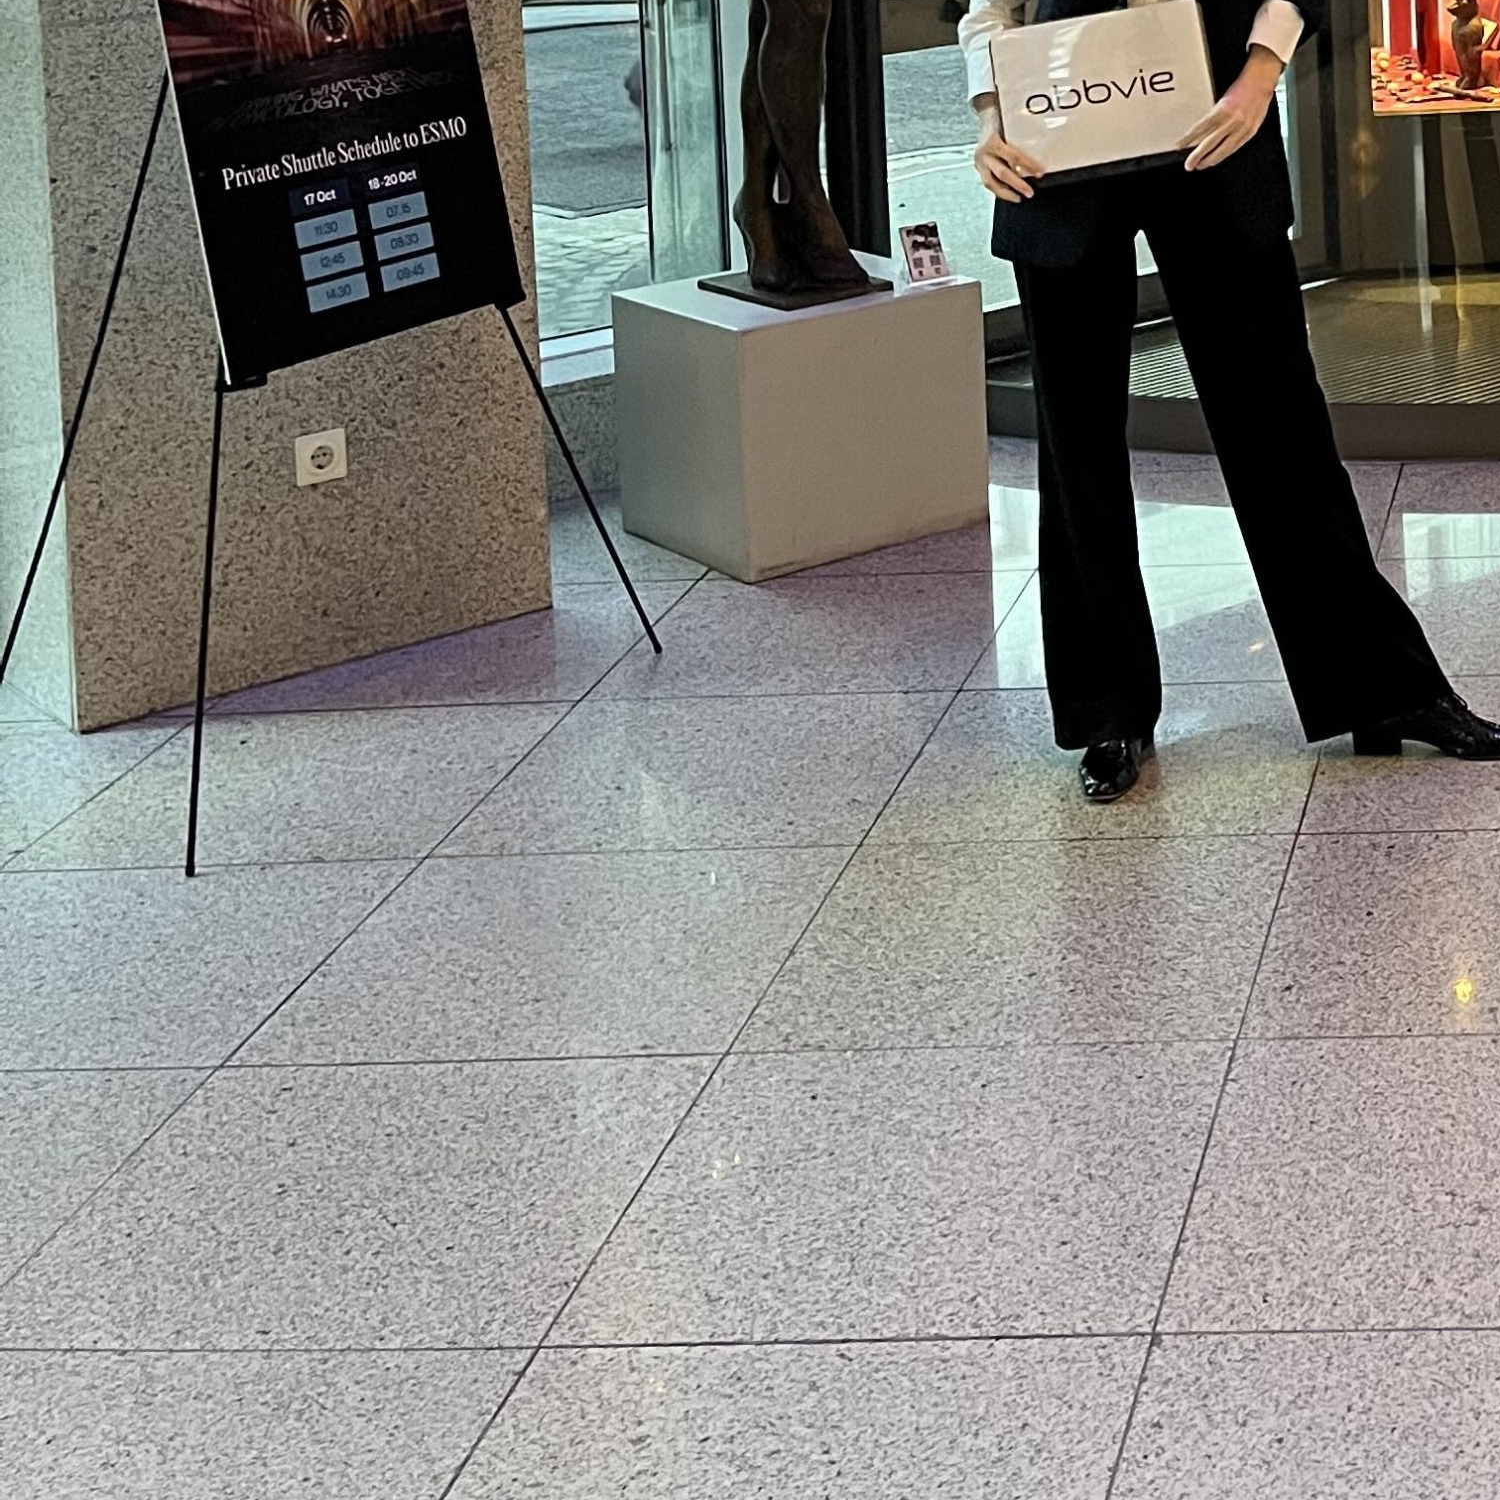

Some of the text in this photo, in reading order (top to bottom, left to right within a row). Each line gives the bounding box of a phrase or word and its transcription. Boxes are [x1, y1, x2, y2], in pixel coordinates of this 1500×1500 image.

[1025, 68, 1176, 116] abbvie
[221, 116, 468, 190] Private Shuttle Schedule to ESMO
[398, 169, 418, 182] Oct
[303, 189, 337, 206] 17 Oct
